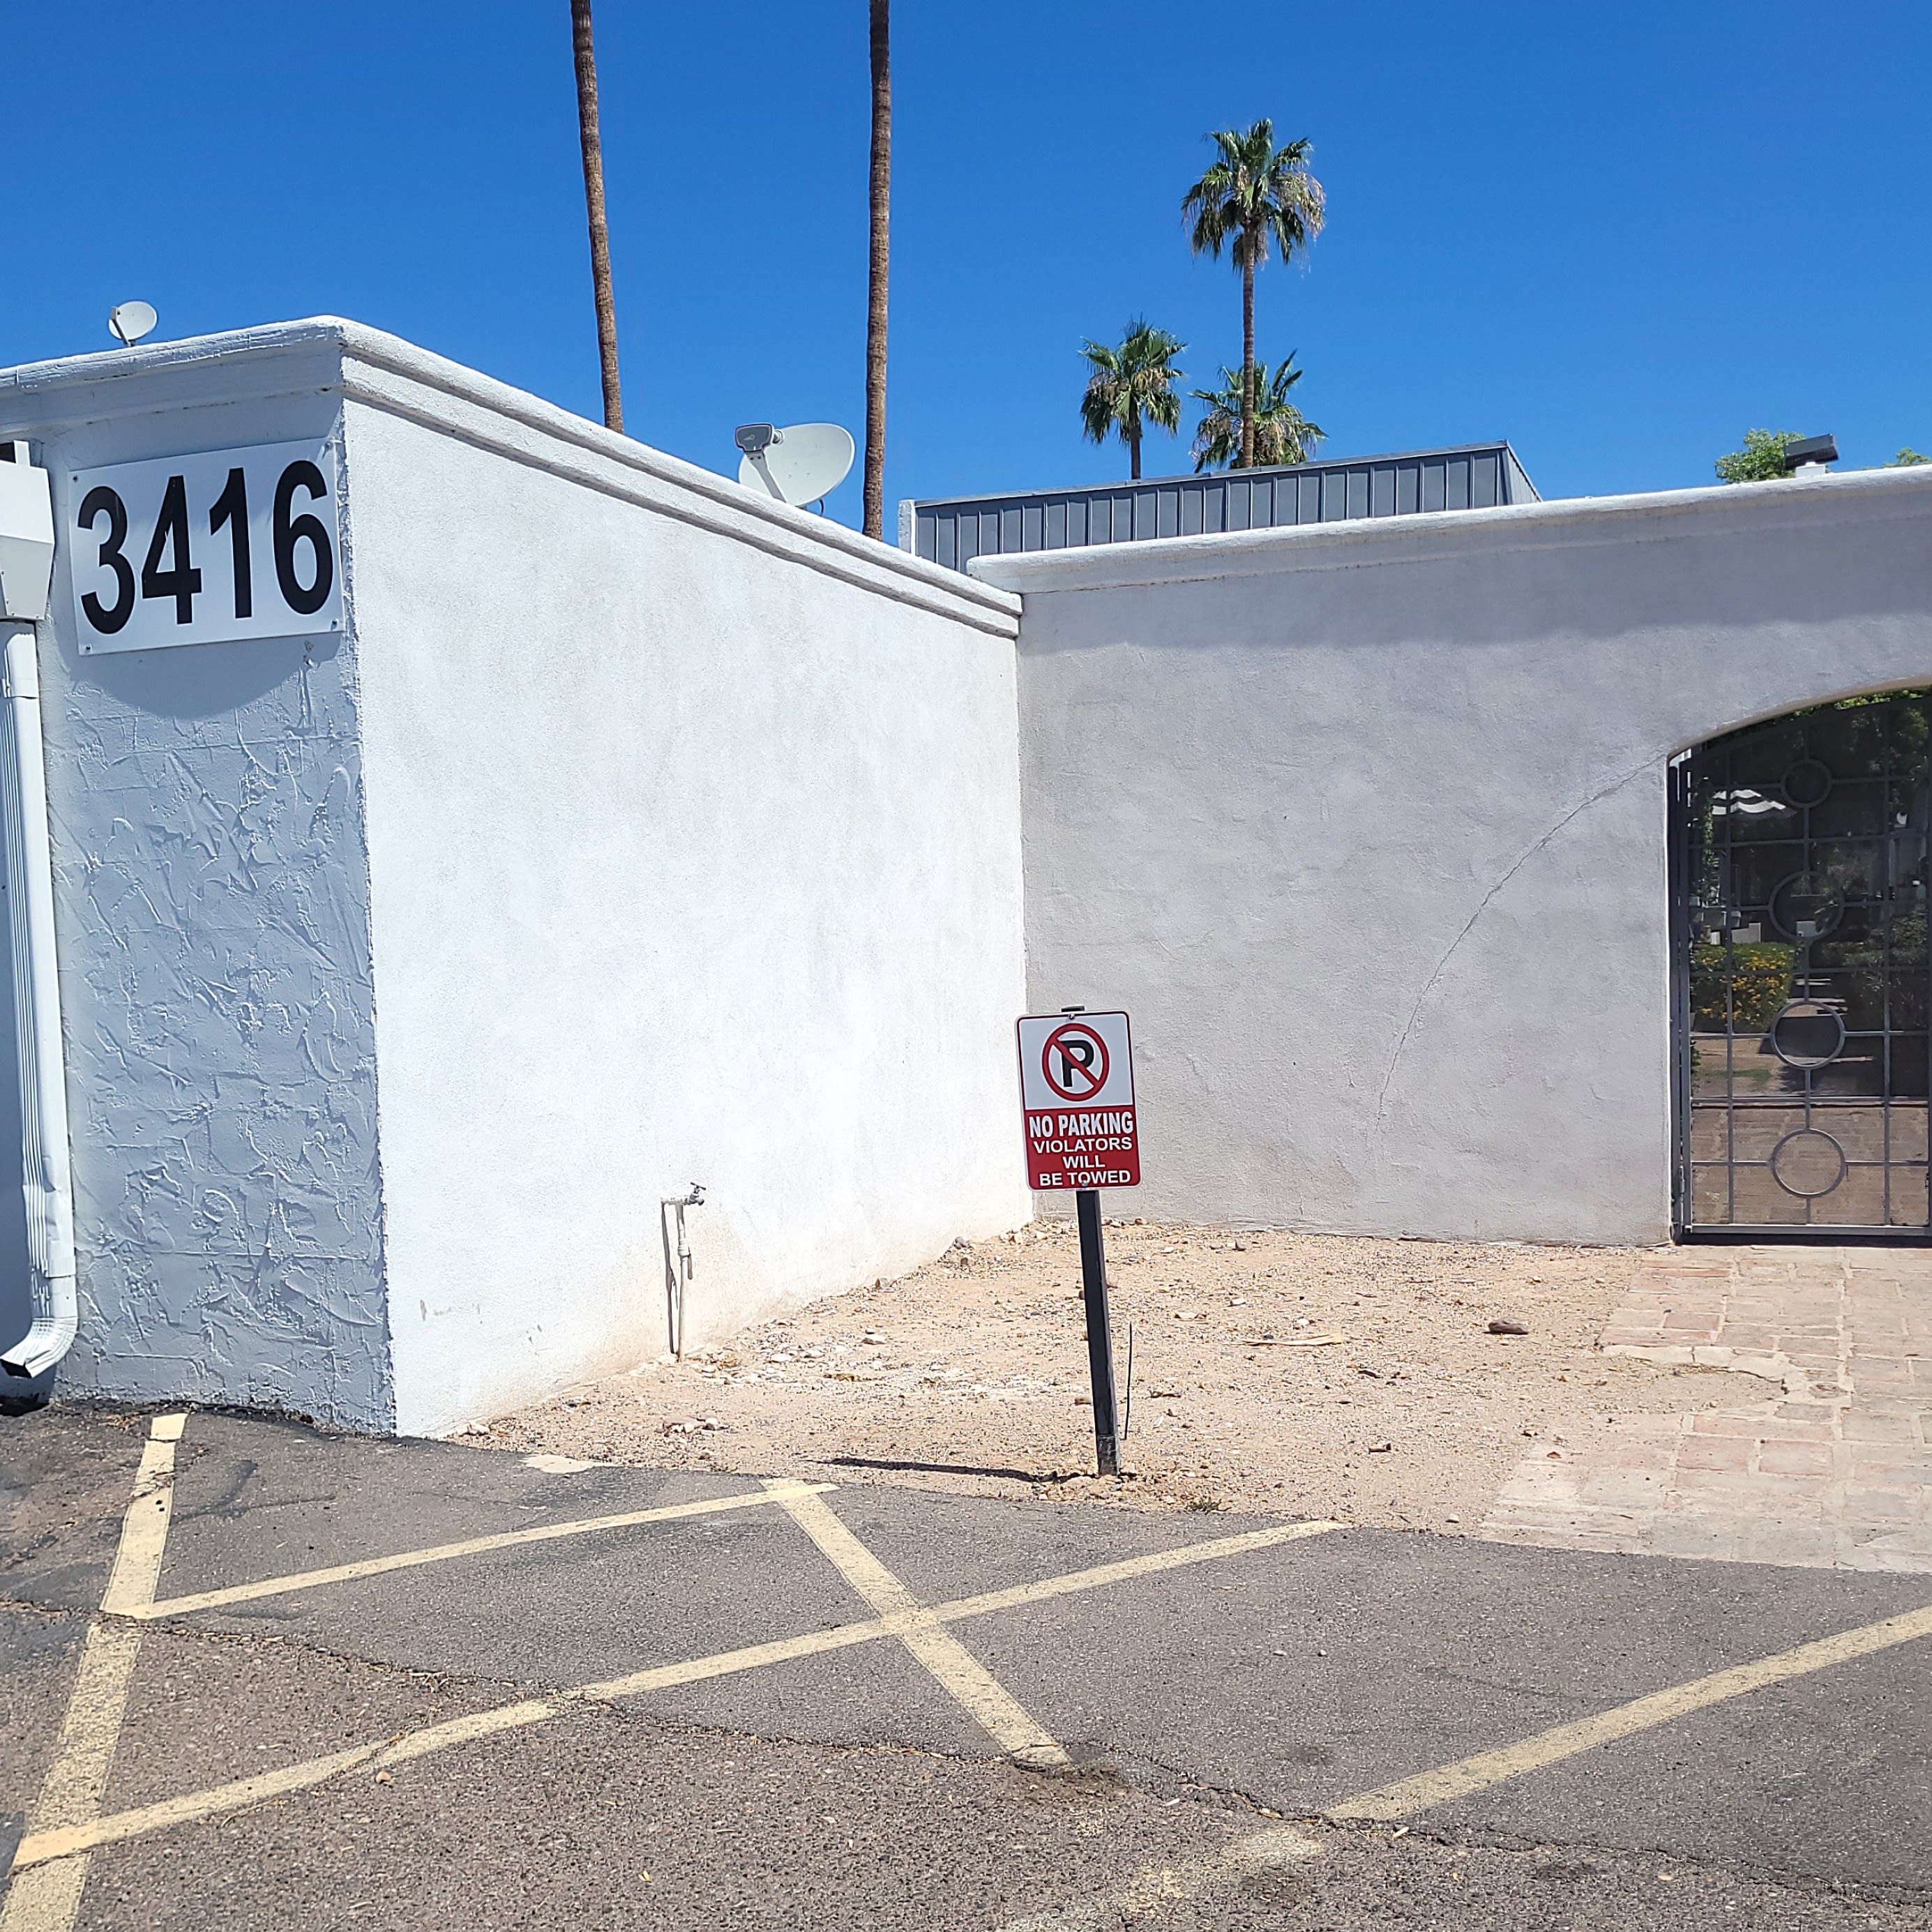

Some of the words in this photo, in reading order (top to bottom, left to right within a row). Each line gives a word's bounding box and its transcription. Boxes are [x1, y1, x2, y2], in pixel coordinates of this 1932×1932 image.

[77, 460, 333, 634] 3416
[1029, 1115, 1053, 1138] NO
[1058, 1111, 1133, 1137] PARKING
[1033, 1137, 1133, 1154] VIOLATORS
[1062, 1155, 1105, 1169] WILL
[1039, 1172, 1062, 1186] BE
[1067, 1170, 1131, 1185] TOWED
